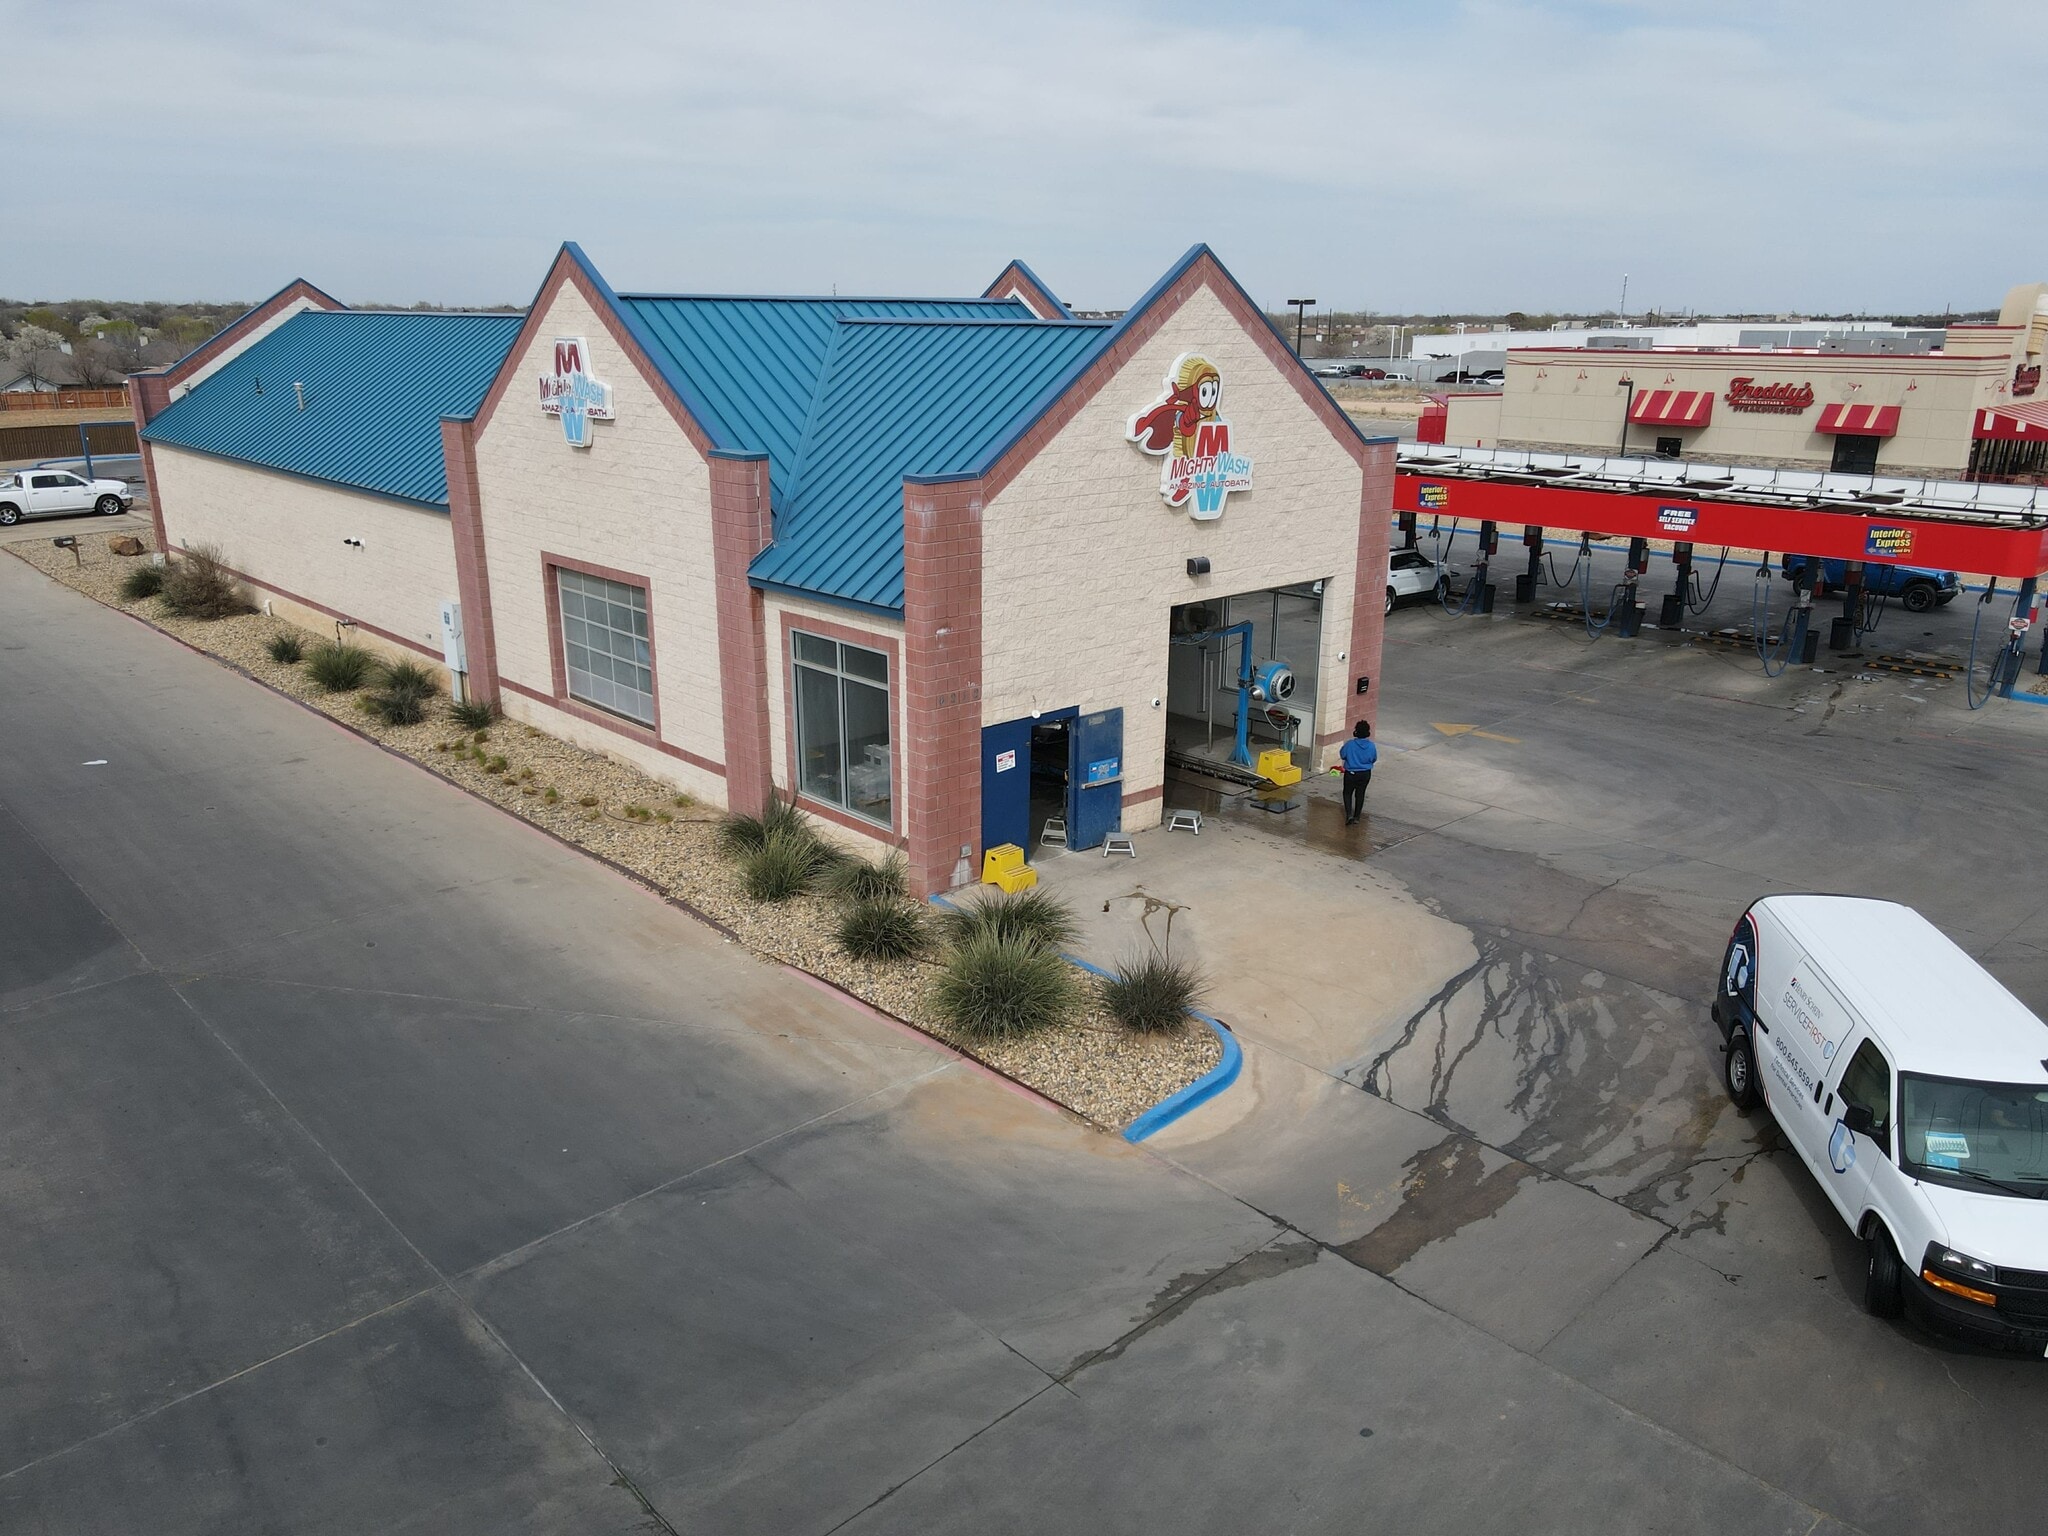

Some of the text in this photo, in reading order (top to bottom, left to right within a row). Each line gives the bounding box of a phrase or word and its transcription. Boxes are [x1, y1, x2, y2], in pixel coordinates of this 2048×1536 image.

[1724, 377, 1814, 404] Freddy's
[541, 404, 607, 417] AMAZ ABATH
[1196, 425, 1229, 457] M
[1170, 452, 1249, 480] MIGHTY WASH
[1169, 480, 1249, 490] AMAZING AUTOBATH
[1421, 486, 1443, 494] Interior
[1671, 517, 1696, 525] SERVICE
[1870, 529, 1905, 538] Interior
[1876, 539, 1911, 547] Express
[1783, 991, 1826, 1048] SERVICEFIRST
[1776, 1036, 1814, 1092] 800.645.6594
